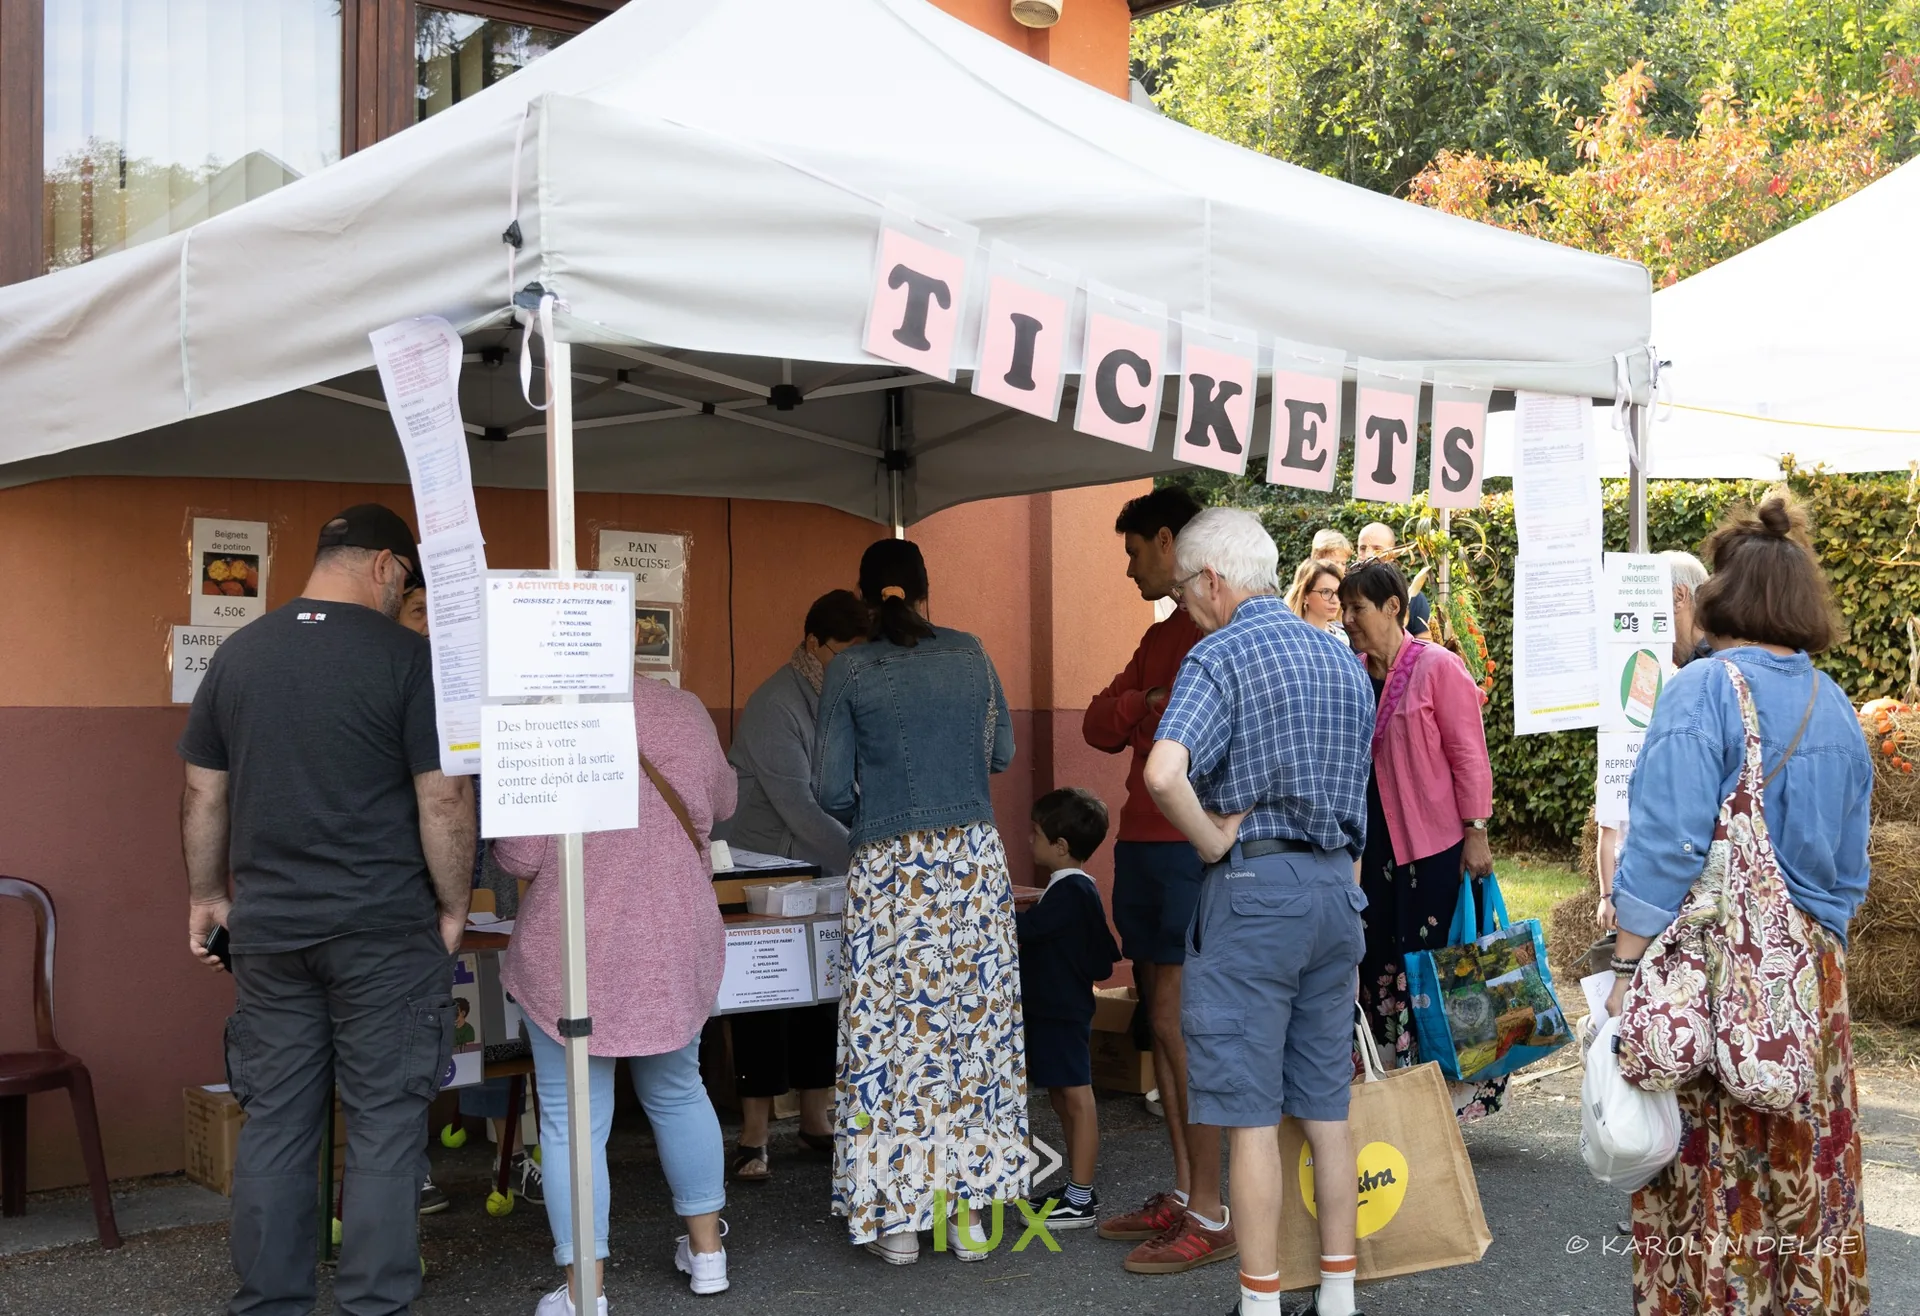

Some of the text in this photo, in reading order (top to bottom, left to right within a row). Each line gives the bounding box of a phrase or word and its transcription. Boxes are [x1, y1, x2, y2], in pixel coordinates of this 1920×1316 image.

[888, 263, 1474, 493] TICKETS
[214, 529, 249, 541] Beignets
[211, 542, 251, 552] de potiron
[628, 541, 657, 554] PAIN
[613, 556, 671, 569] SAUCISSE
[635, 573, 648, 583] 4€
[1621, 575, 1660, 583] UNIQUEMENT
[507, 582, 514, 590] 3
[516, 581, 570, 591] ACTIVITÉS
[573, 582, 598, 591] POUR
[213, 606, 246, 617] 4,50€
[182, 634, 223, 646] BARBE
[184, 656, 211, 672] 2,5
[497, 718, 600, 732] Des brouettes sont
[497, 737, 577, 751] mises à votre
[497, 752, 615, 771] disposition à la sortie
[498, 770, 624, 788] contre dépôt de la carte
[498, 790, 558, 805] d'identité
[1230, 871, 1256, 879] Columbia
[728, 929, 761, 937] ACTIVITÉS
